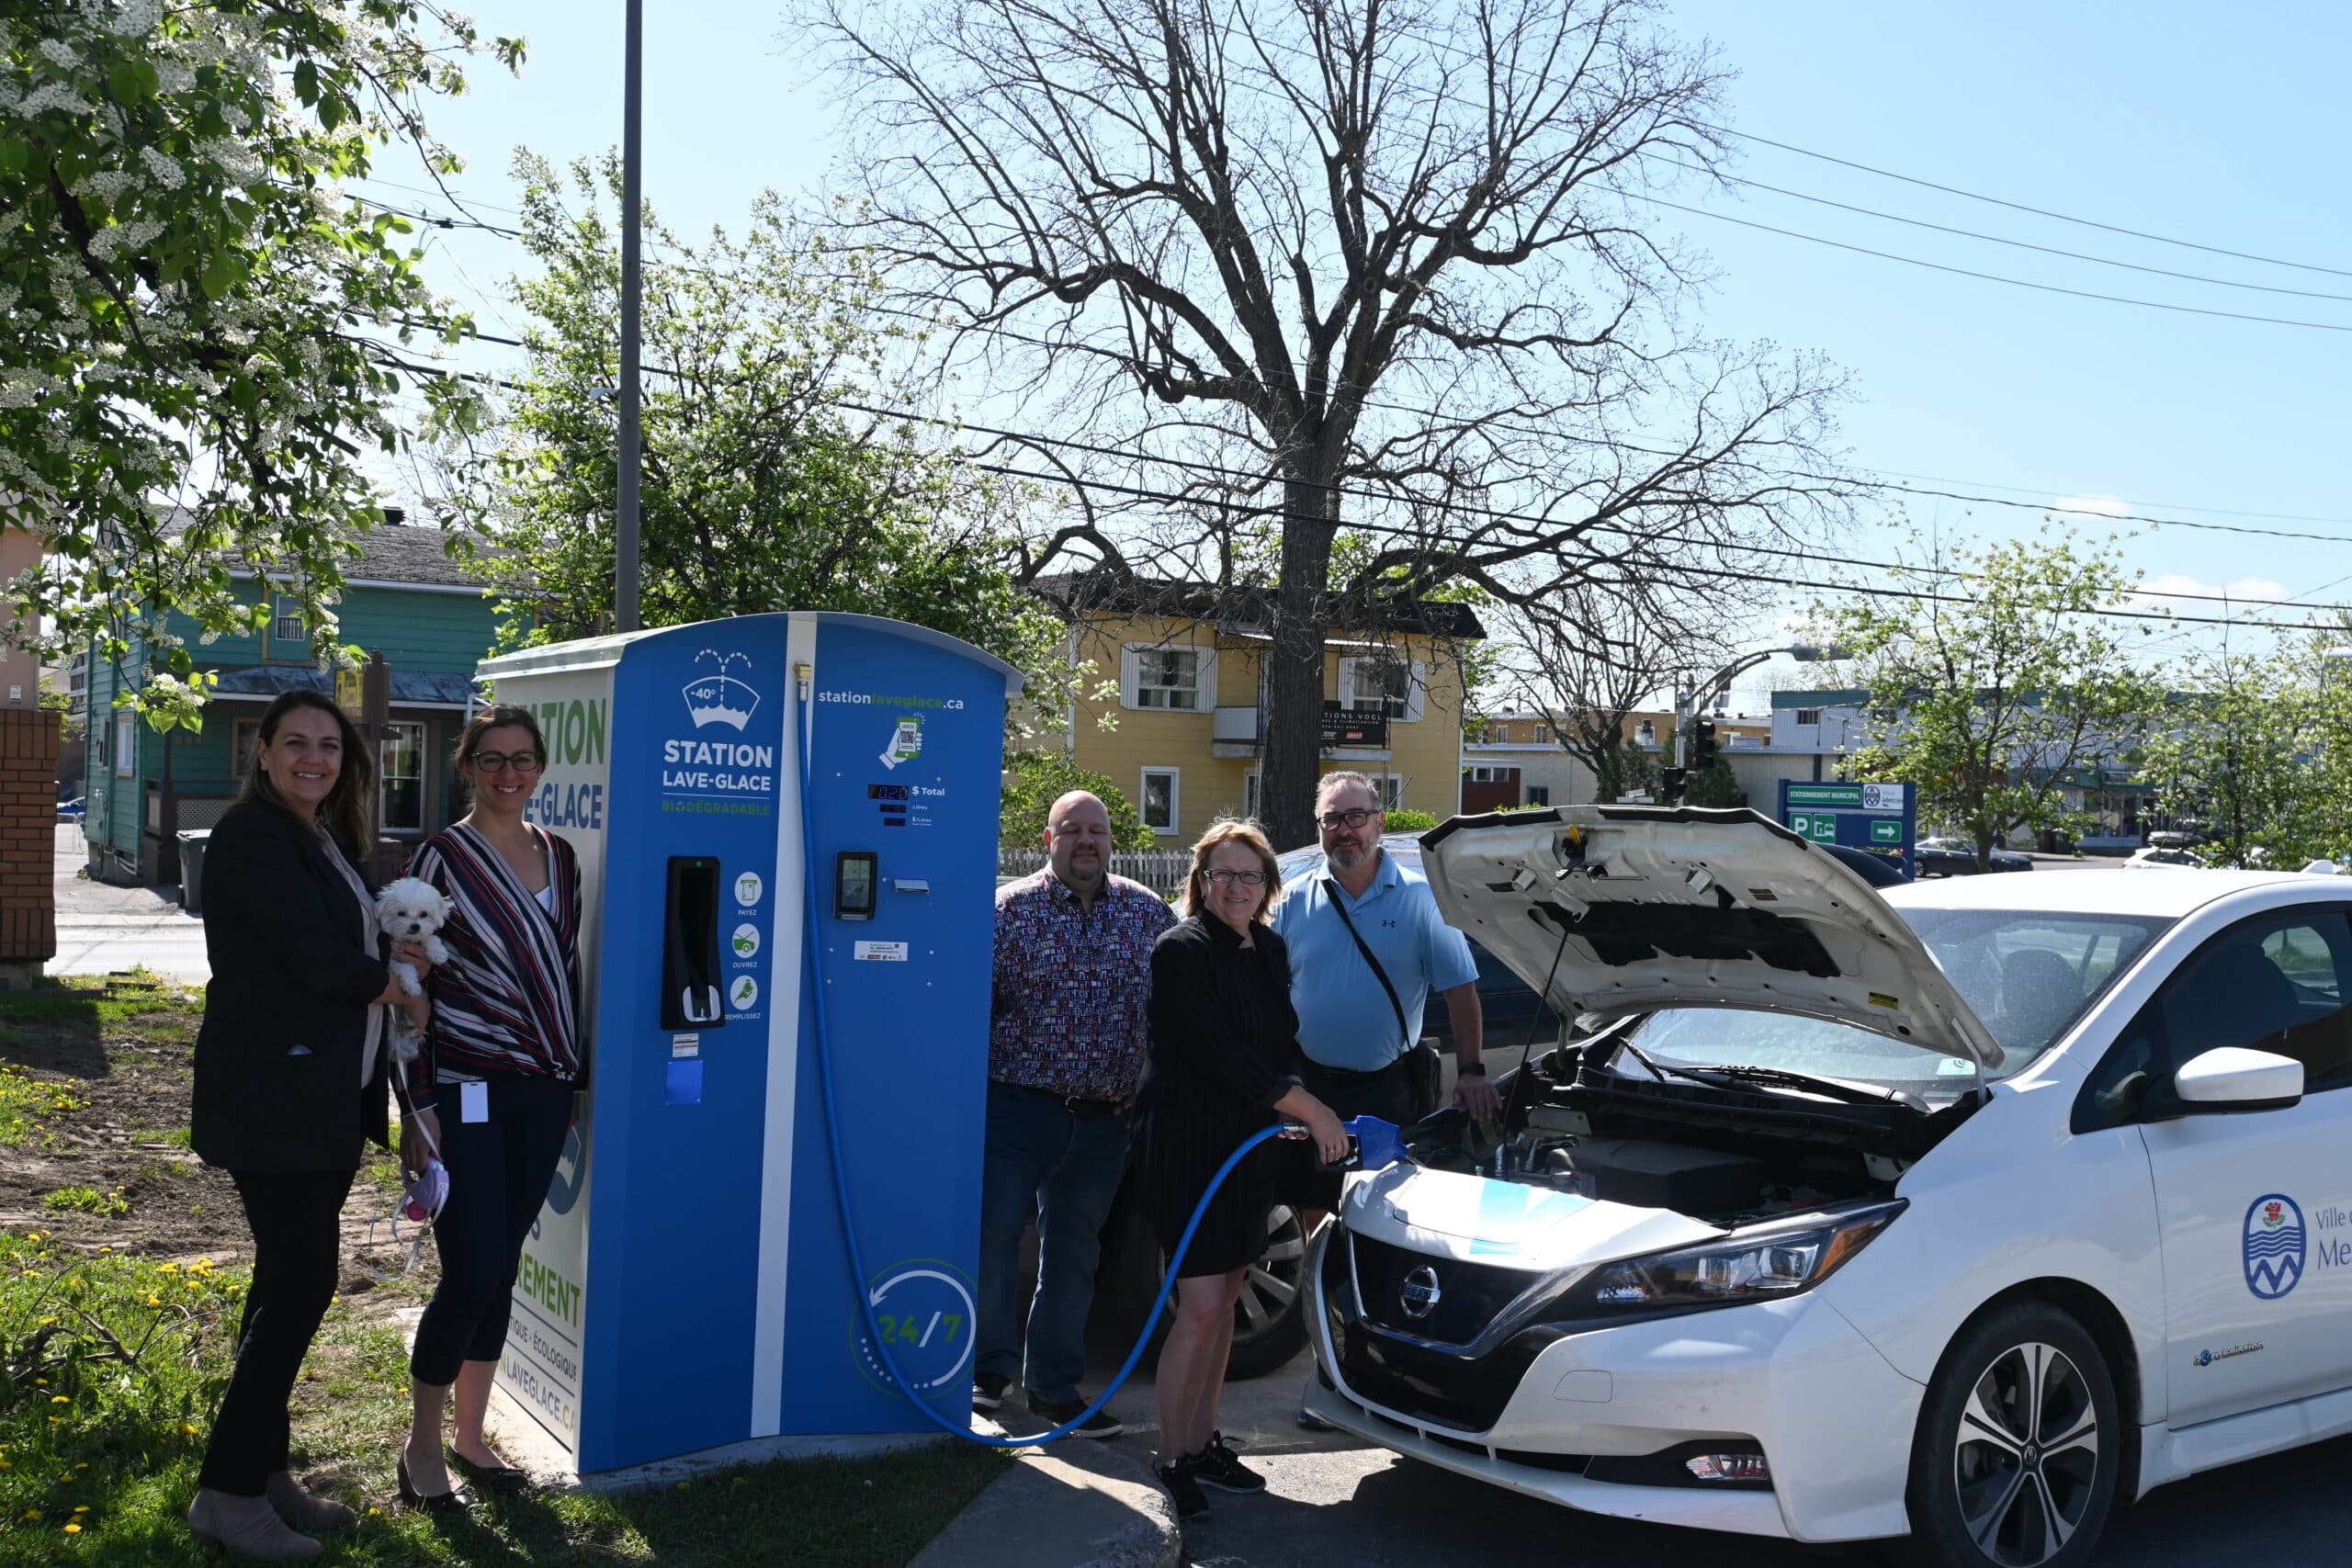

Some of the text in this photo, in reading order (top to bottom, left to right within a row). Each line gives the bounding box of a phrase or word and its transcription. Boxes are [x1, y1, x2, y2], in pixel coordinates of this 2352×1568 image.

[818, 690, 964, 710] stationlaveglace.ca
[663, 739, 773, 769] STATION
[662, 770, 772, 792] LAVE-GLACE
[922, 787, 945, 796] Total
[1790, 791, 1831, 799] STATIONNEMENT
[724, 1012, 762, 1021] REMPLISSEZ
[2315, 1206, 2346, 1231] Ville
[877, 1311, 963, 1348] 24/7
